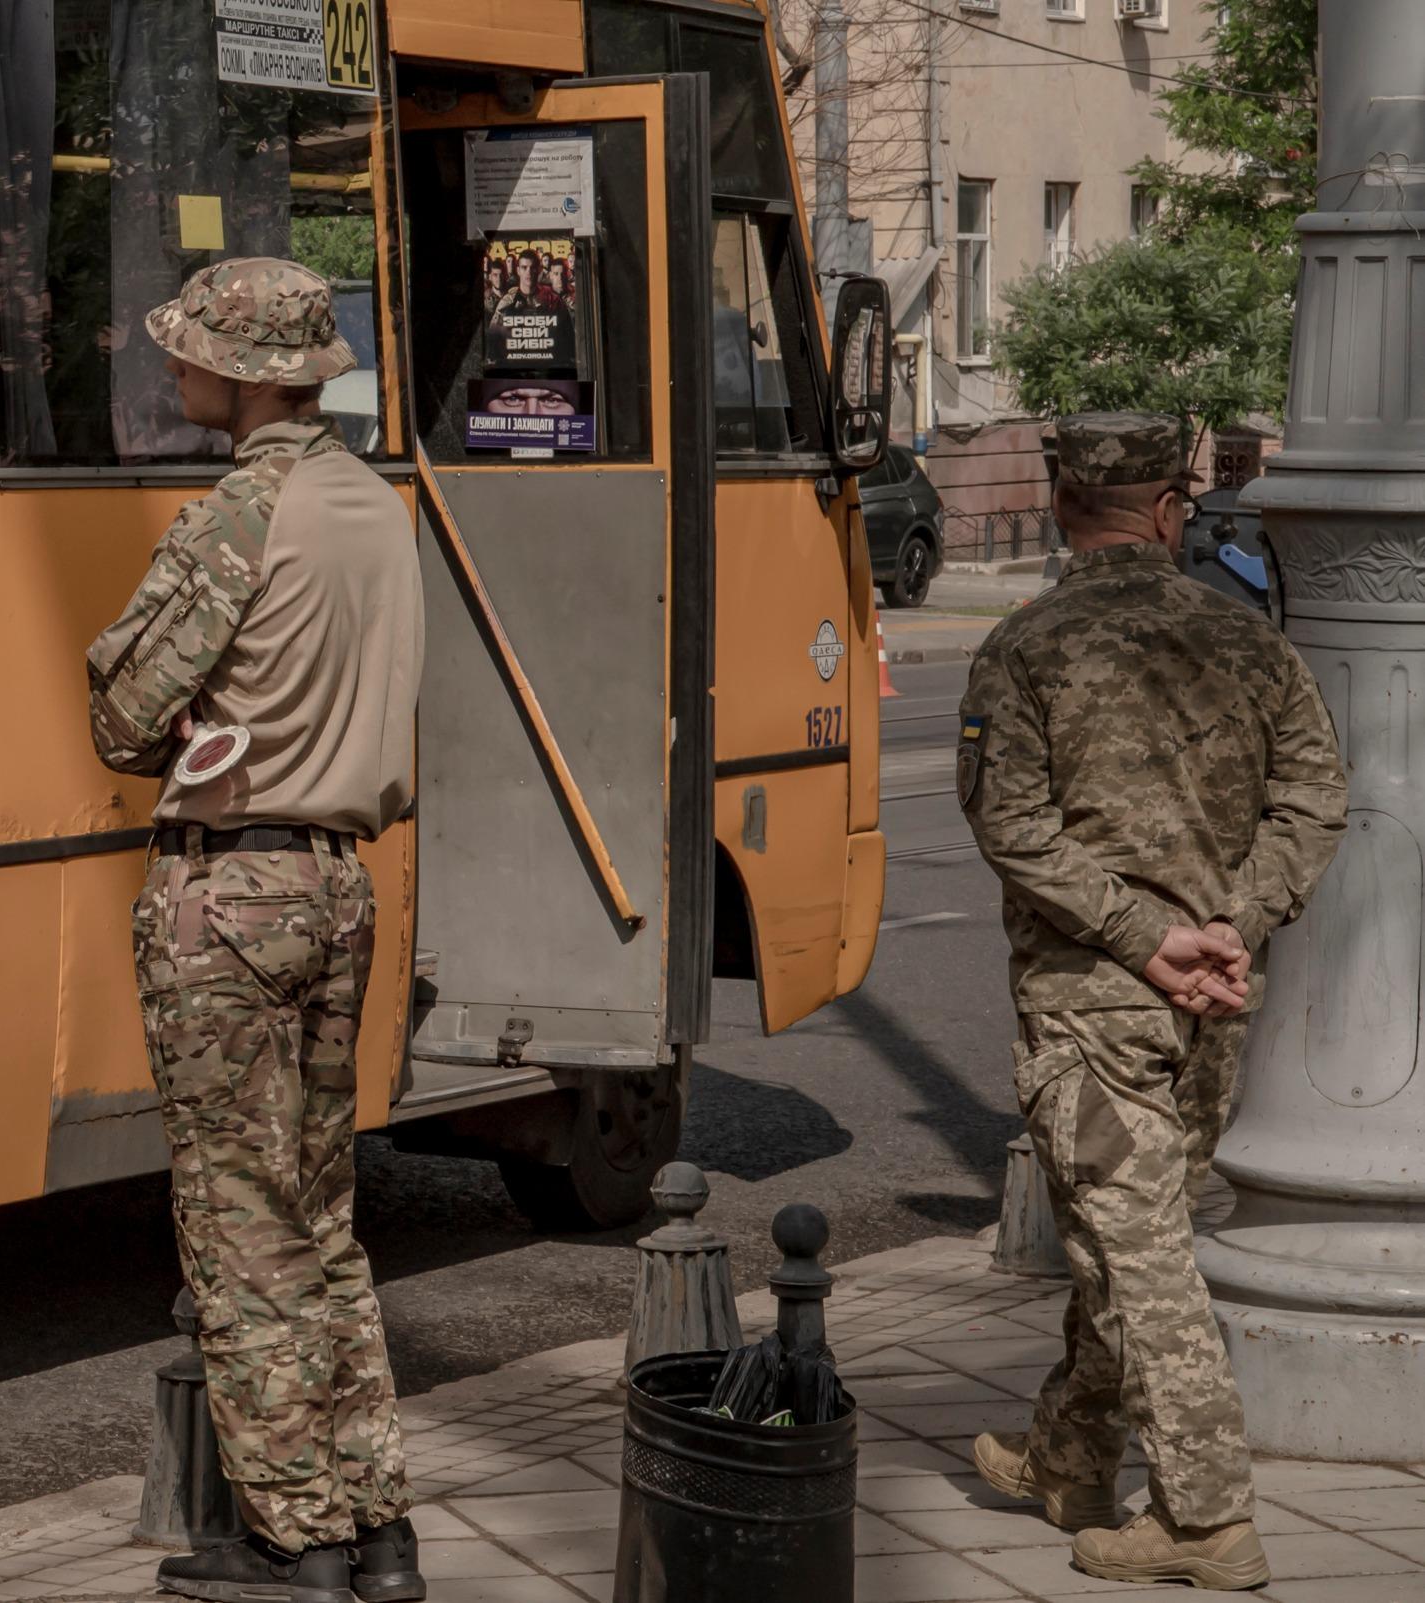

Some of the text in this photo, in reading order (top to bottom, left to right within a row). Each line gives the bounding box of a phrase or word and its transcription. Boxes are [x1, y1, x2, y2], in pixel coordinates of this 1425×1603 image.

[225, 20, 275, 37] МАРШРУТНЕ
[276, 27, 300, 41] ТАКСІ
[327, 0, 371, 84] 242
[489, 240, 572, 260] АЗОВ
[502, 315, 558, 327] ЗРОБИ
[511, 325, 549, 338] СВІЙ
[506, 338, 554, 350] ВИБІР
[506, 352, 554, 360] AZOV.ORG.UA
[470, 416, 506, 431] СЛУЖИТИ
[507, 417, 511, 430] І
[512, 417, 554, 433] ЗАХИЩАТИ
[805, 705, 842, 749] 1527
